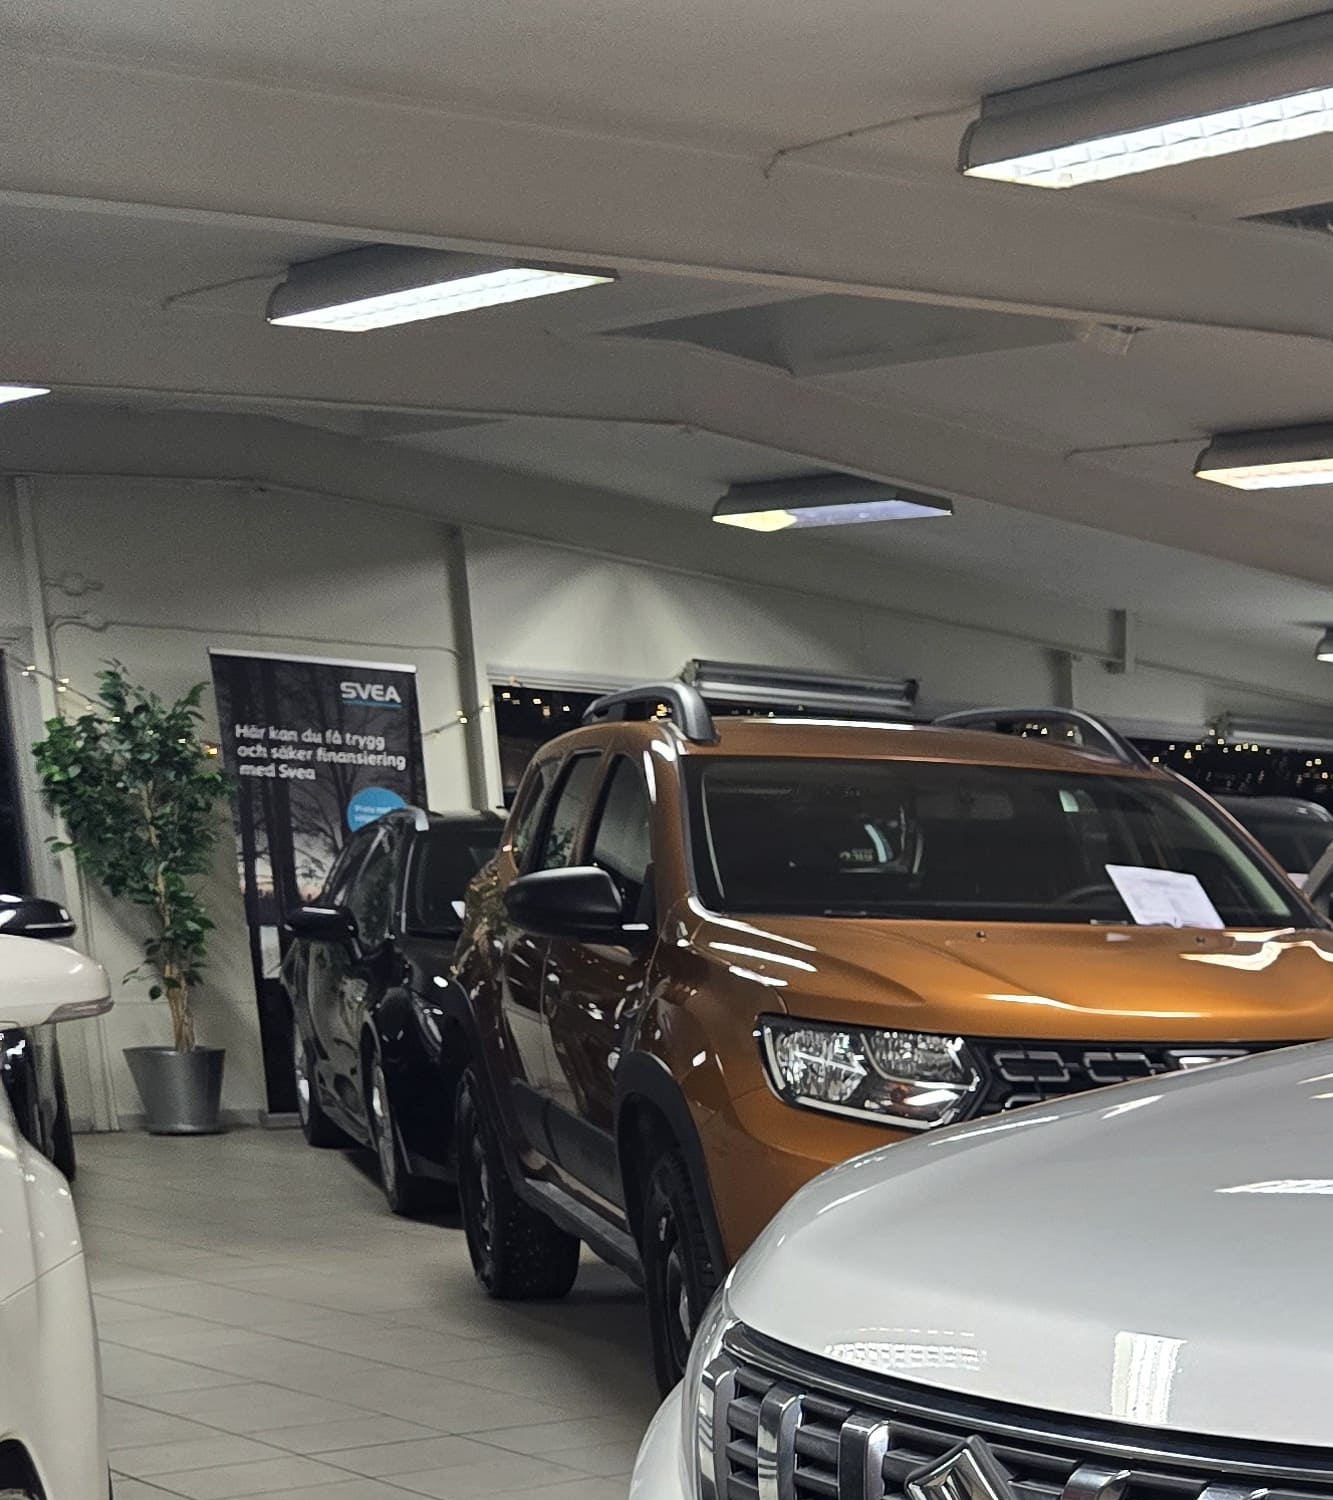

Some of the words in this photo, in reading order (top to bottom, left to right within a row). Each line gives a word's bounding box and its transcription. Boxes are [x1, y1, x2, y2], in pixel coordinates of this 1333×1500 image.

[340, 681, 402, 703] SVEA
[234, 723, 266, 740] Här
[268, 726, 299, 742] kan
[301, 727, 323, 744] du
[325, 729, 342, 745] få
[345, 732, 385, 751] trygg
[237, 744, 268, 759] och
[271, 745, 313, 761] säker
[316, 747, 406, 771] finansiering
[239, 763, 276, 778] med
[278, 763, 316, 780] Svea
